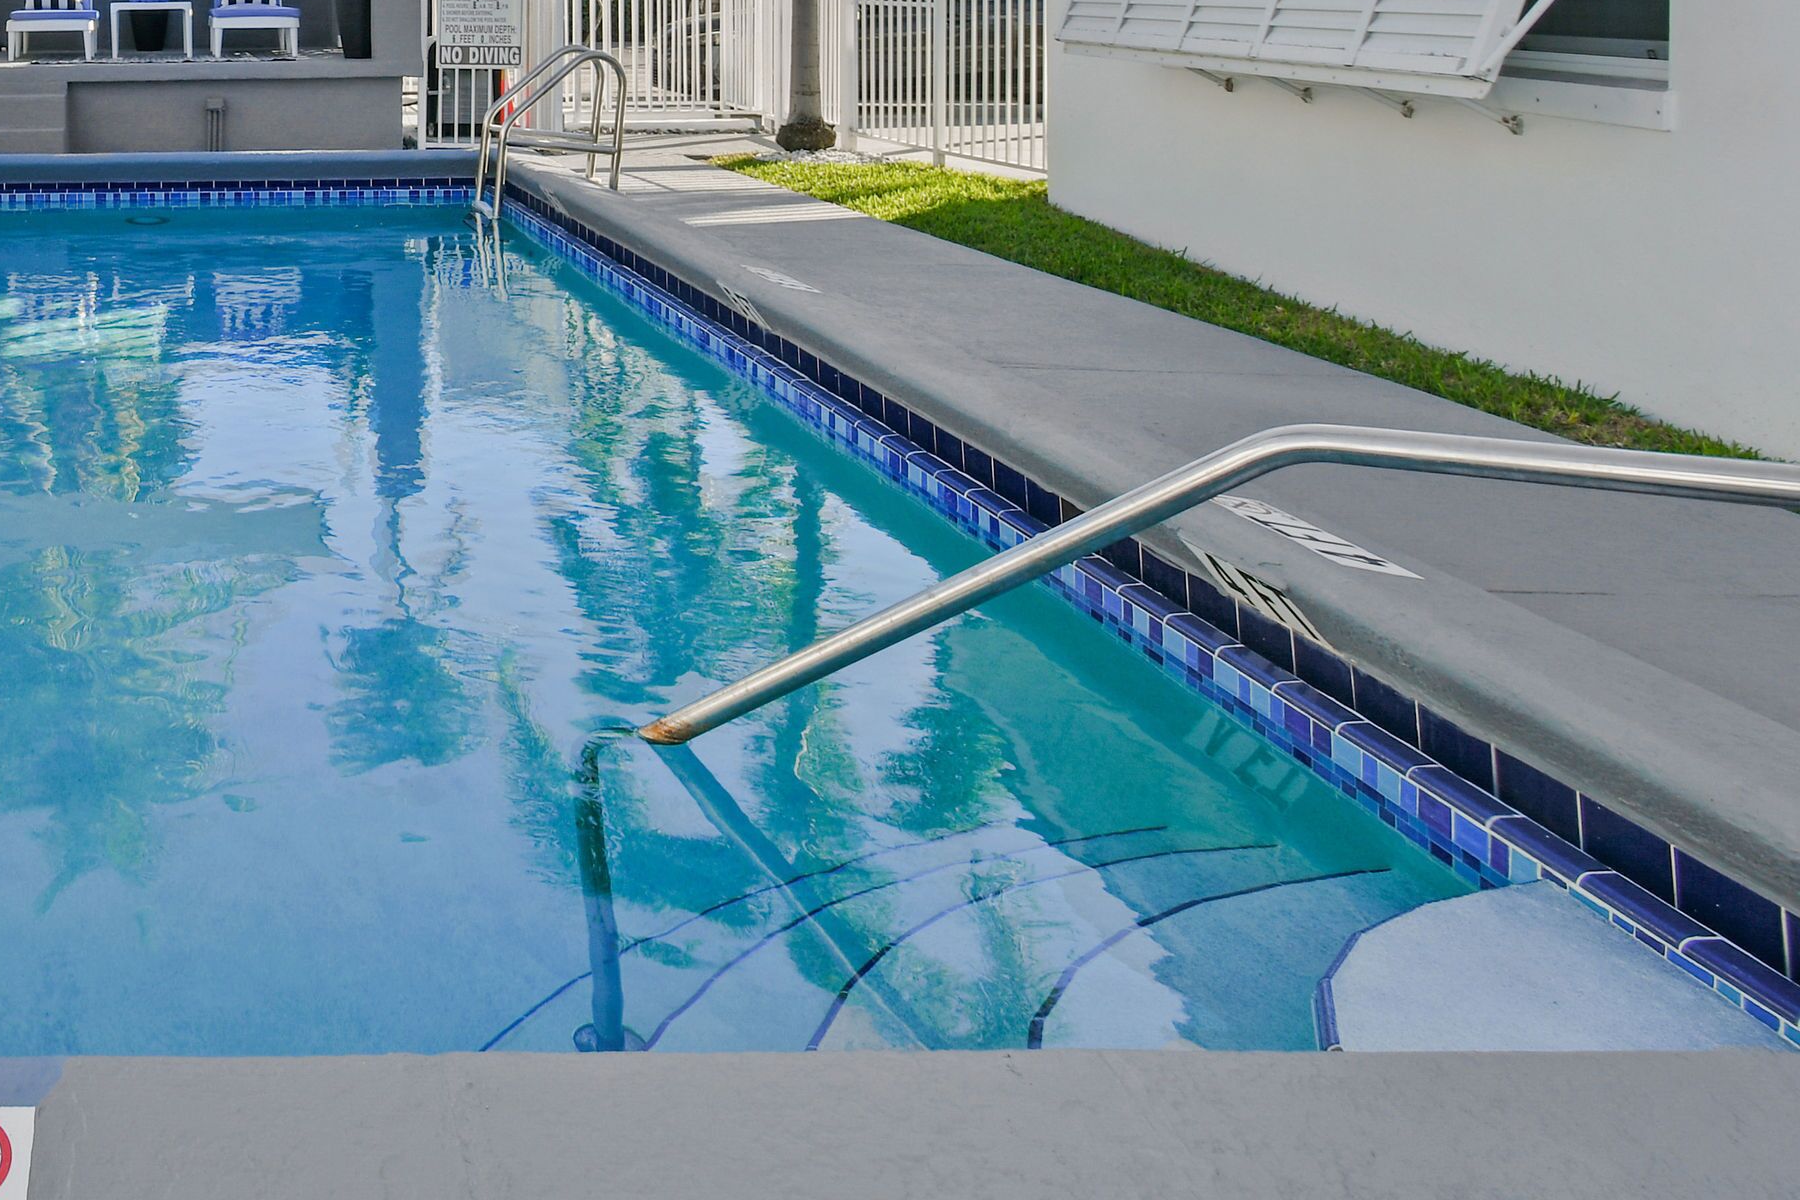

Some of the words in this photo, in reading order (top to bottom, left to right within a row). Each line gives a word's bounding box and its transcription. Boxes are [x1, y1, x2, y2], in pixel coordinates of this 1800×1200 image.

[445, 24, 462, 33] POOL
[463, 24, 494, 33] MAXIMUM
[459, 34, 475, 44] FEET
[488, 34, 511, 44] INCHES
[441, 46, 463, 64] NO
[469, 46, 521, 64] DIVING
[1205, 553, 1255, 606] 4
[1234, 568, 1320, 640] FT
